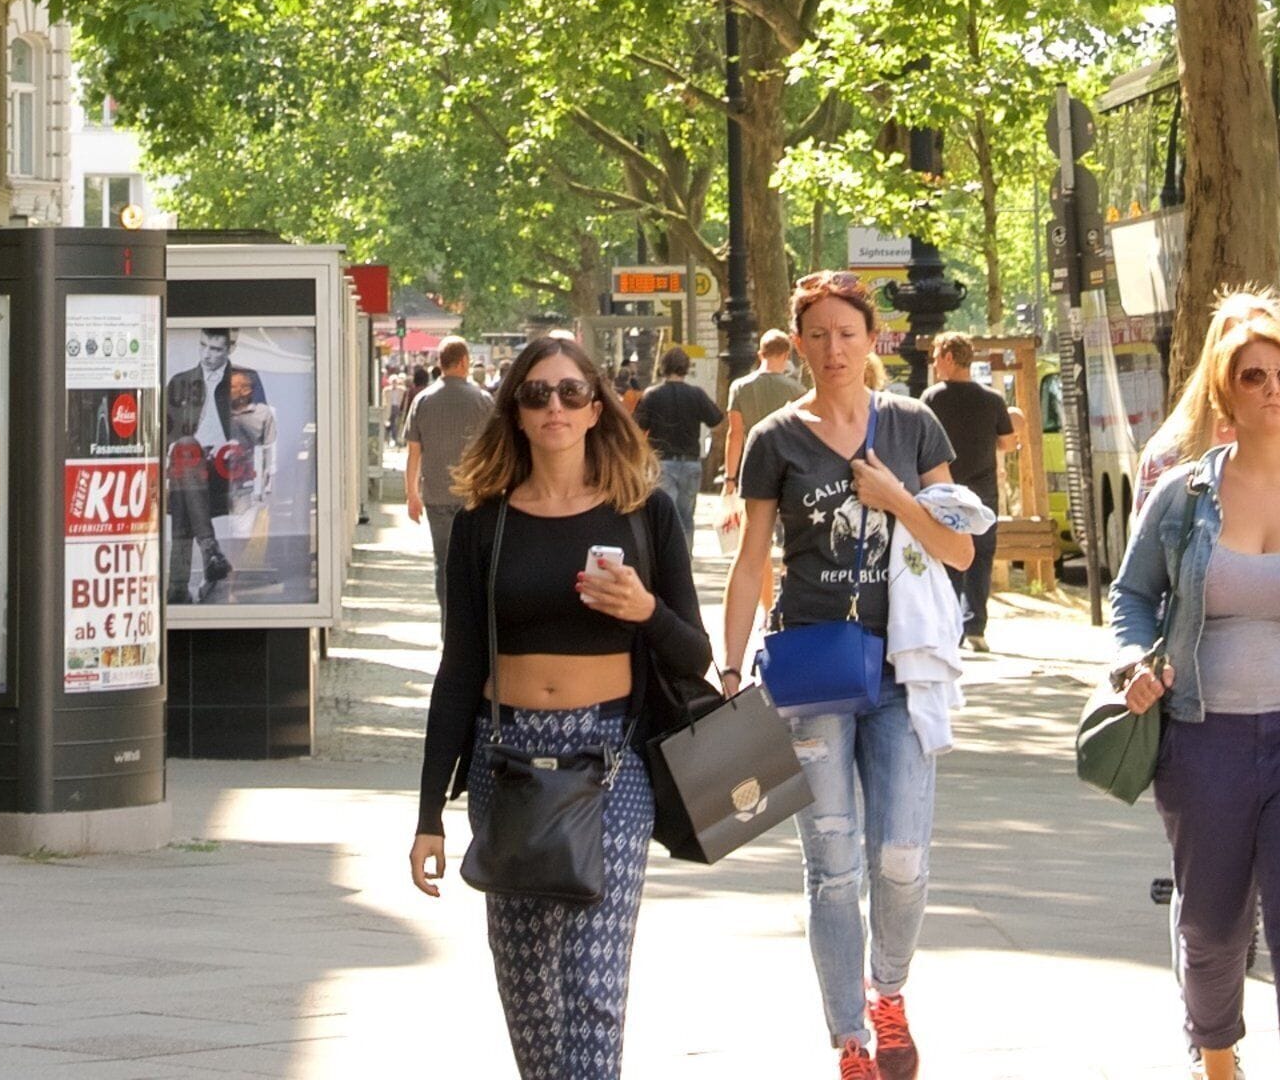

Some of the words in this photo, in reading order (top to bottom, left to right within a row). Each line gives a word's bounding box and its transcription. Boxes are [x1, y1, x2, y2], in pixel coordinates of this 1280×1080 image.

[859, 246, 910, 258] Sightseein
[84, 470, 147, 522] KLO
[95, 542, 148, 574] CITY
[72, 575, 157, 609] BUFFET
[75, 622, 96, 640] ab
[104, 613, 117, 640] €
[123, 611, 153, 643] 7,60
